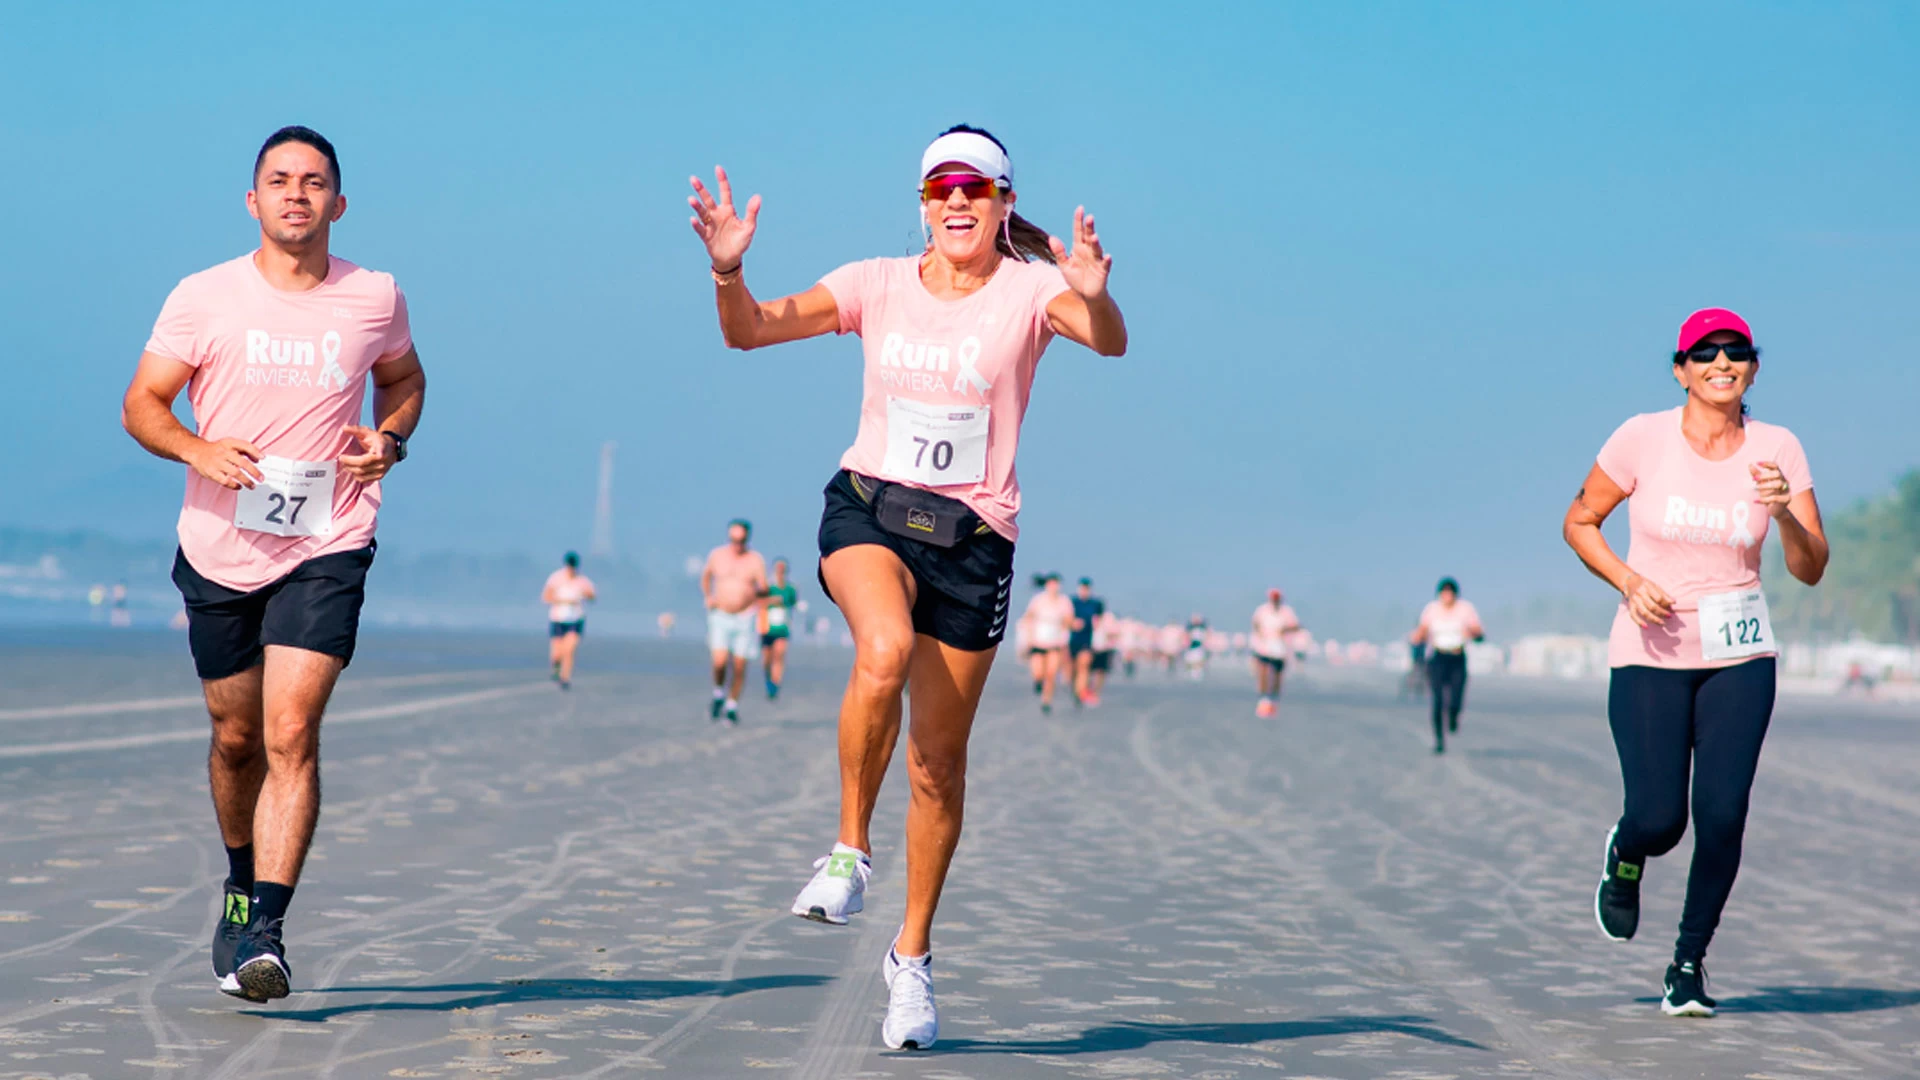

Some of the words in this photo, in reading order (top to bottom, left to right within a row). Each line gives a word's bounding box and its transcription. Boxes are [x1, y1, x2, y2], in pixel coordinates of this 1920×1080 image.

[246, 329, 315, 366] Run
[880, 332, 950, 372] Run
[245, 367, 313, 388] RIVIERA
[880, 369, 949, 393] RIVIERA
[913, 435, 954, 472] 70
[265, 492, 308, 525] 27
[1664, 495, 1726, 529] Run
[1662, 525, 1722, 545] RIVIERA
[1718, 617, 1763, 647] 122
